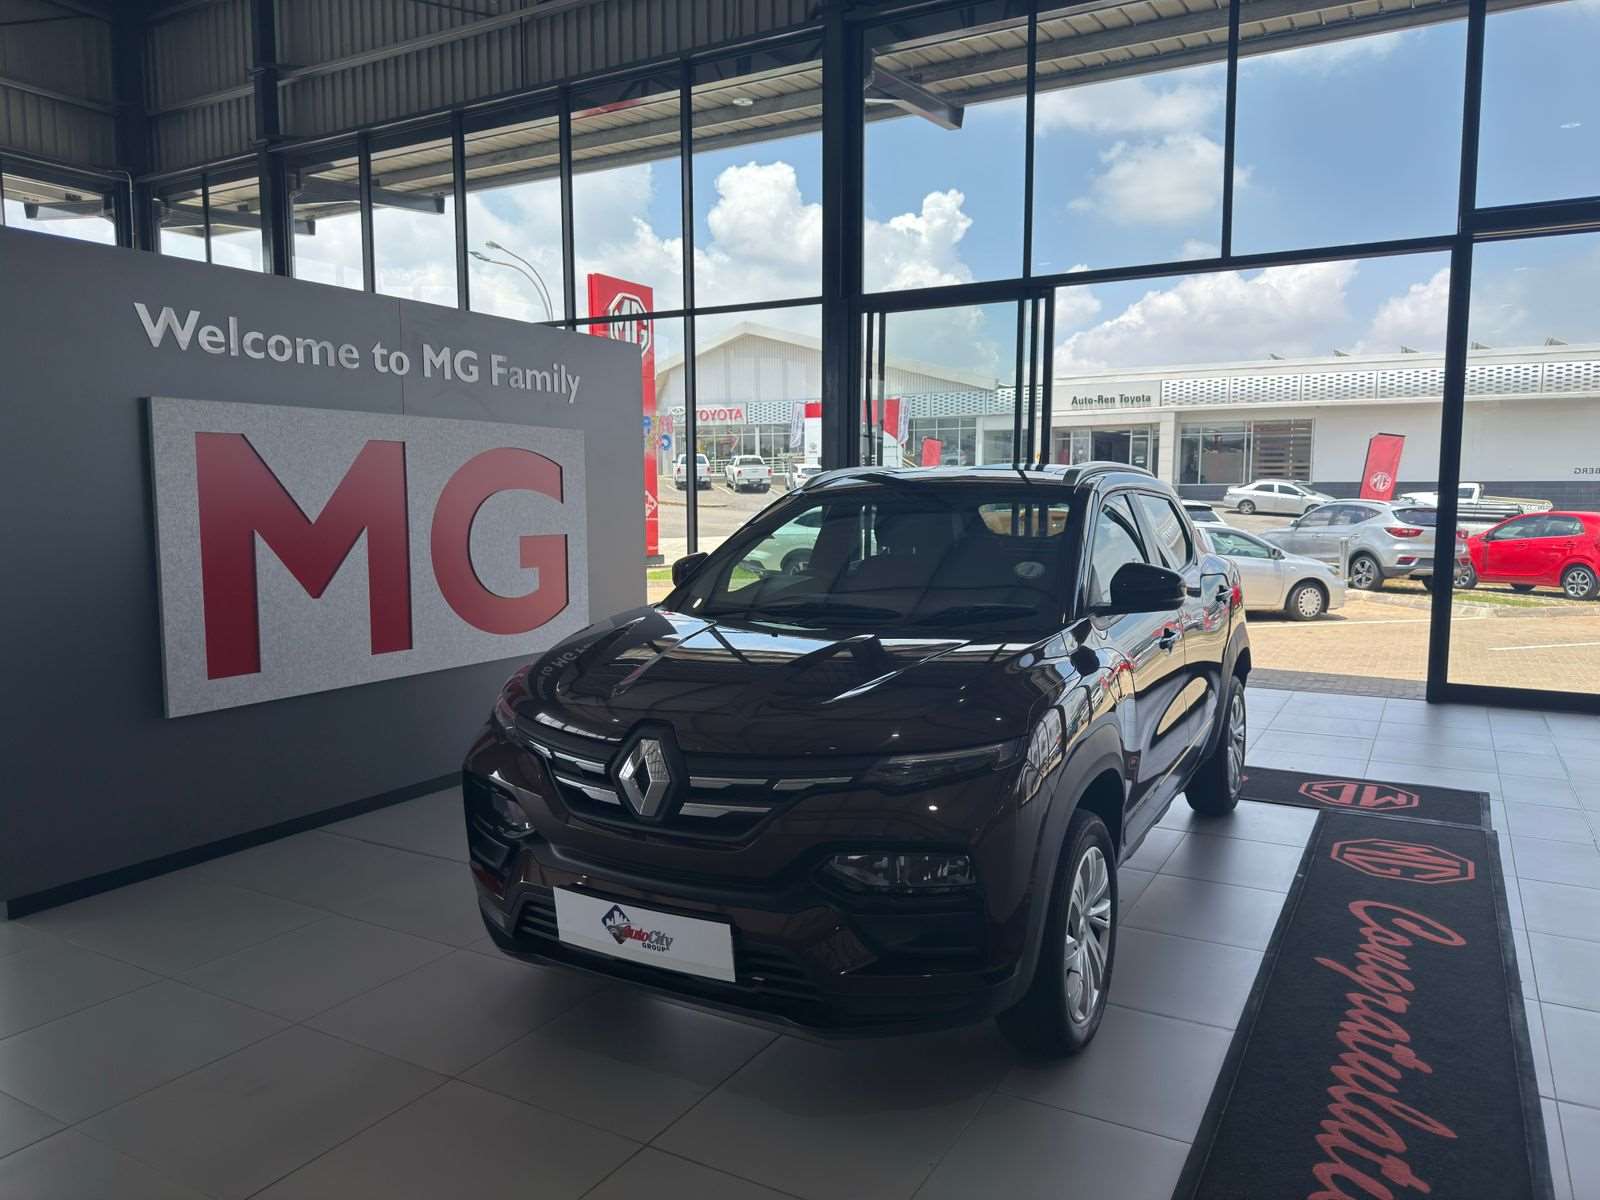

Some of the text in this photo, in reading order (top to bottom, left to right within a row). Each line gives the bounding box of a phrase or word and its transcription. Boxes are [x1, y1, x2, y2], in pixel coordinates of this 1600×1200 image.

[133, 302, 582, 405] Welcome to MG Family
[1071, 393, 1152, 406] Auto-Ren Toyota
[195, 432, 570, 681] MG
[642, 942, 667, 952] GROUP
